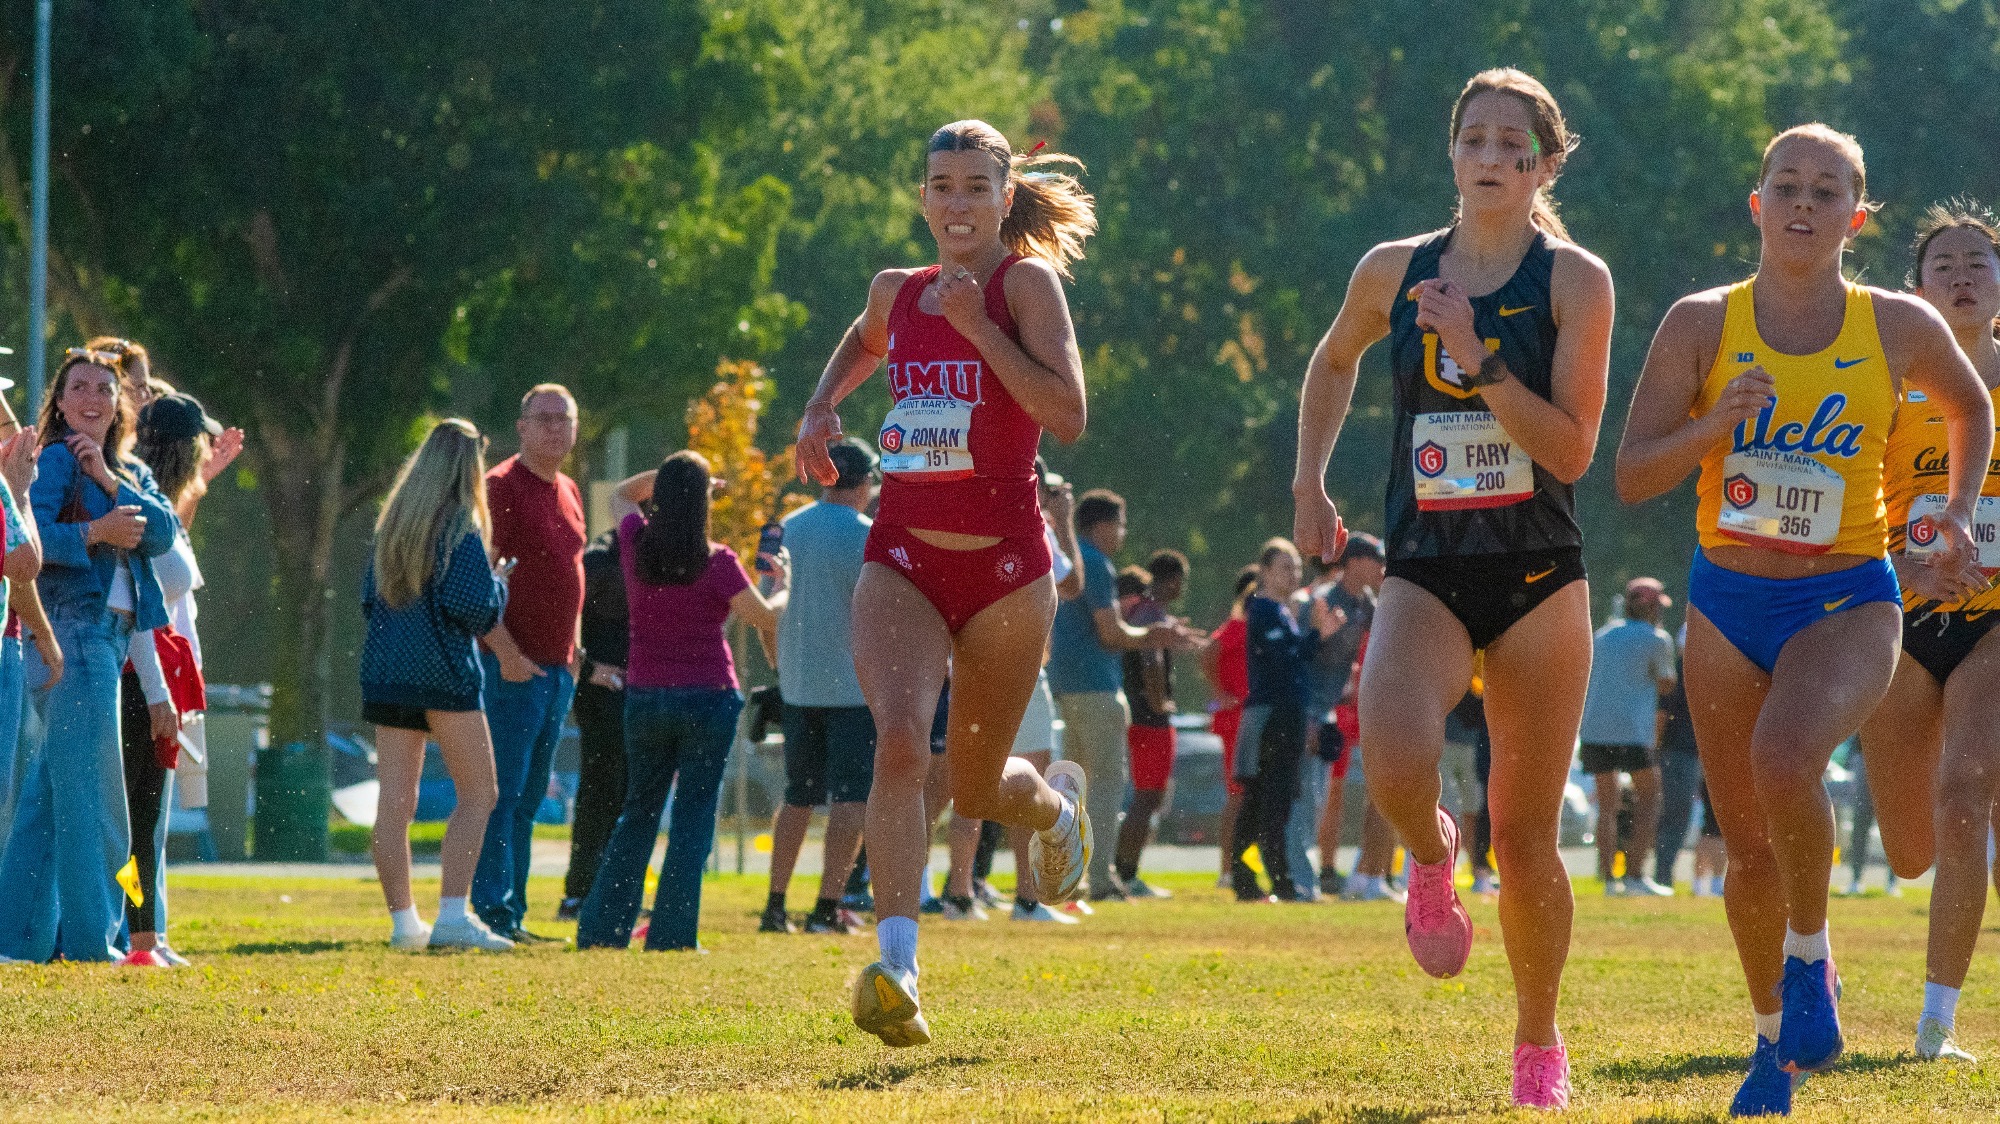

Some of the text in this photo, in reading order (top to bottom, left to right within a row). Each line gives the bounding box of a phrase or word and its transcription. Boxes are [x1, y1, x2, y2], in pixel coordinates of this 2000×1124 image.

[888, 360, 981, 406] LMU
[898, 400, 957, 410] SAINT MARY'S
[904, 409, 944, 417] INVITATIONAL
[1428, 414, 1461, 424] SAINT
[1440, 423, 1497, 431] INVITATIONAL
[910, 427, 960, 447] RONAN
[925, 450, 949, 467] 151
[1424, 451, 1437, 470] G
[1465, 443, 1511, 468] FARY
[1744, 448, 1827, 474] SAINT MARY'S
[1756, 460, 1813, 474] INVITATIONAL
[1476, 471, 1506, 491] 200
[1734, 484, 1747, 501] G
[1776, 485, 1824, 513] LOTT
[1925, 494, 1948, 504] SAIN
[1780, 515, 1811, 537] 356
[1917, 525, 1928, 540] G
